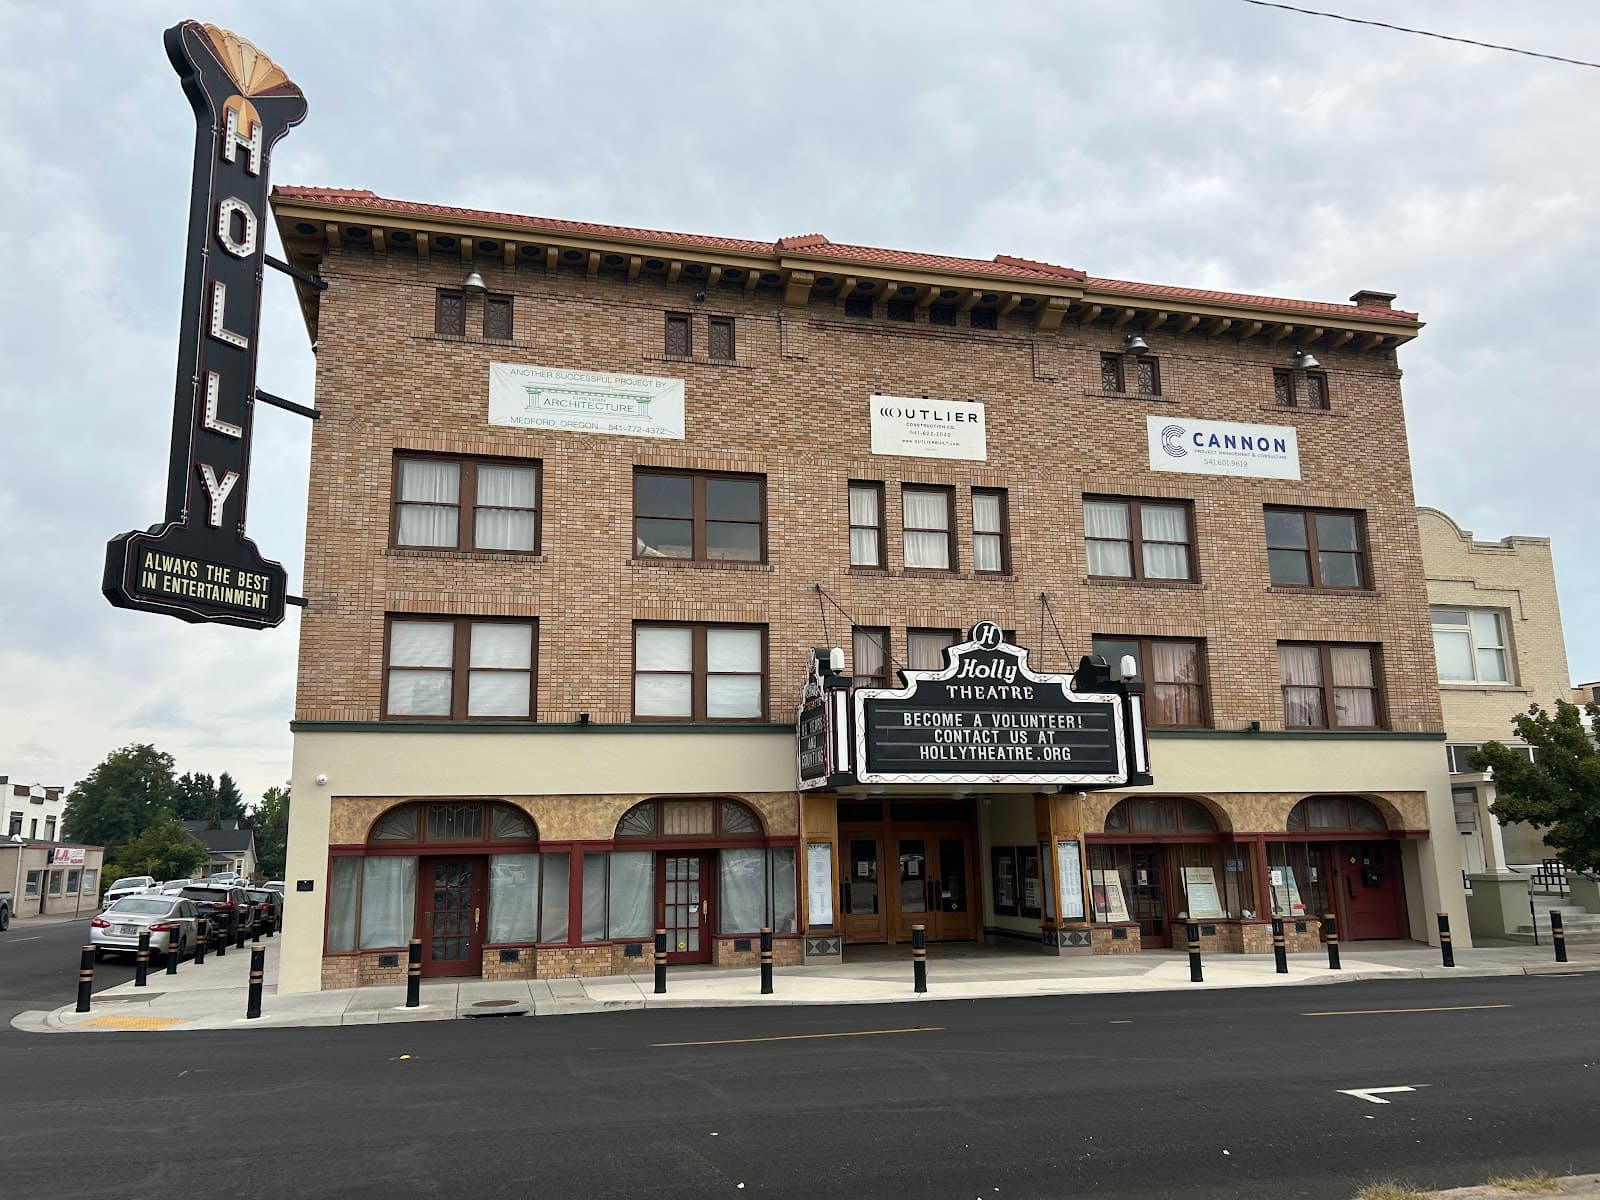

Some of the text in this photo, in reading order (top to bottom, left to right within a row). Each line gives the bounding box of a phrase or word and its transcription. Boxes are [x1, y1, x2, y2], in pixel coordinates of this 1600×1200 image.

[198, 106, 263, 528] HOLLY
[510, 368, 553, 379] ANOTHER
[555, 373, 612, 384] SUCCESSFUL
[615, 378, 653, 388] PROJECT
[543, 398, 634, 413] ARCHITECTURE
[510, 416, 665, 434] MEDFORD, OREGON 541-772-4372
[1193, 432, 1286, 453] CANNON
[144, 552, 269, 592] ALWAYS THE BEST
[142, 571, 268, 610] IN ENTERTAINMENT
[958, 658, 1018, 683] Holly
[946, 685, 1034, 701] THEATRE
[903, 712, 1083, 729] BECOME A VOLUNTEER!
[934, 730, 1056, 744] CONTACT US AT
[920, 746, 1071, 761] HOLLYTHEATRE.ORG
